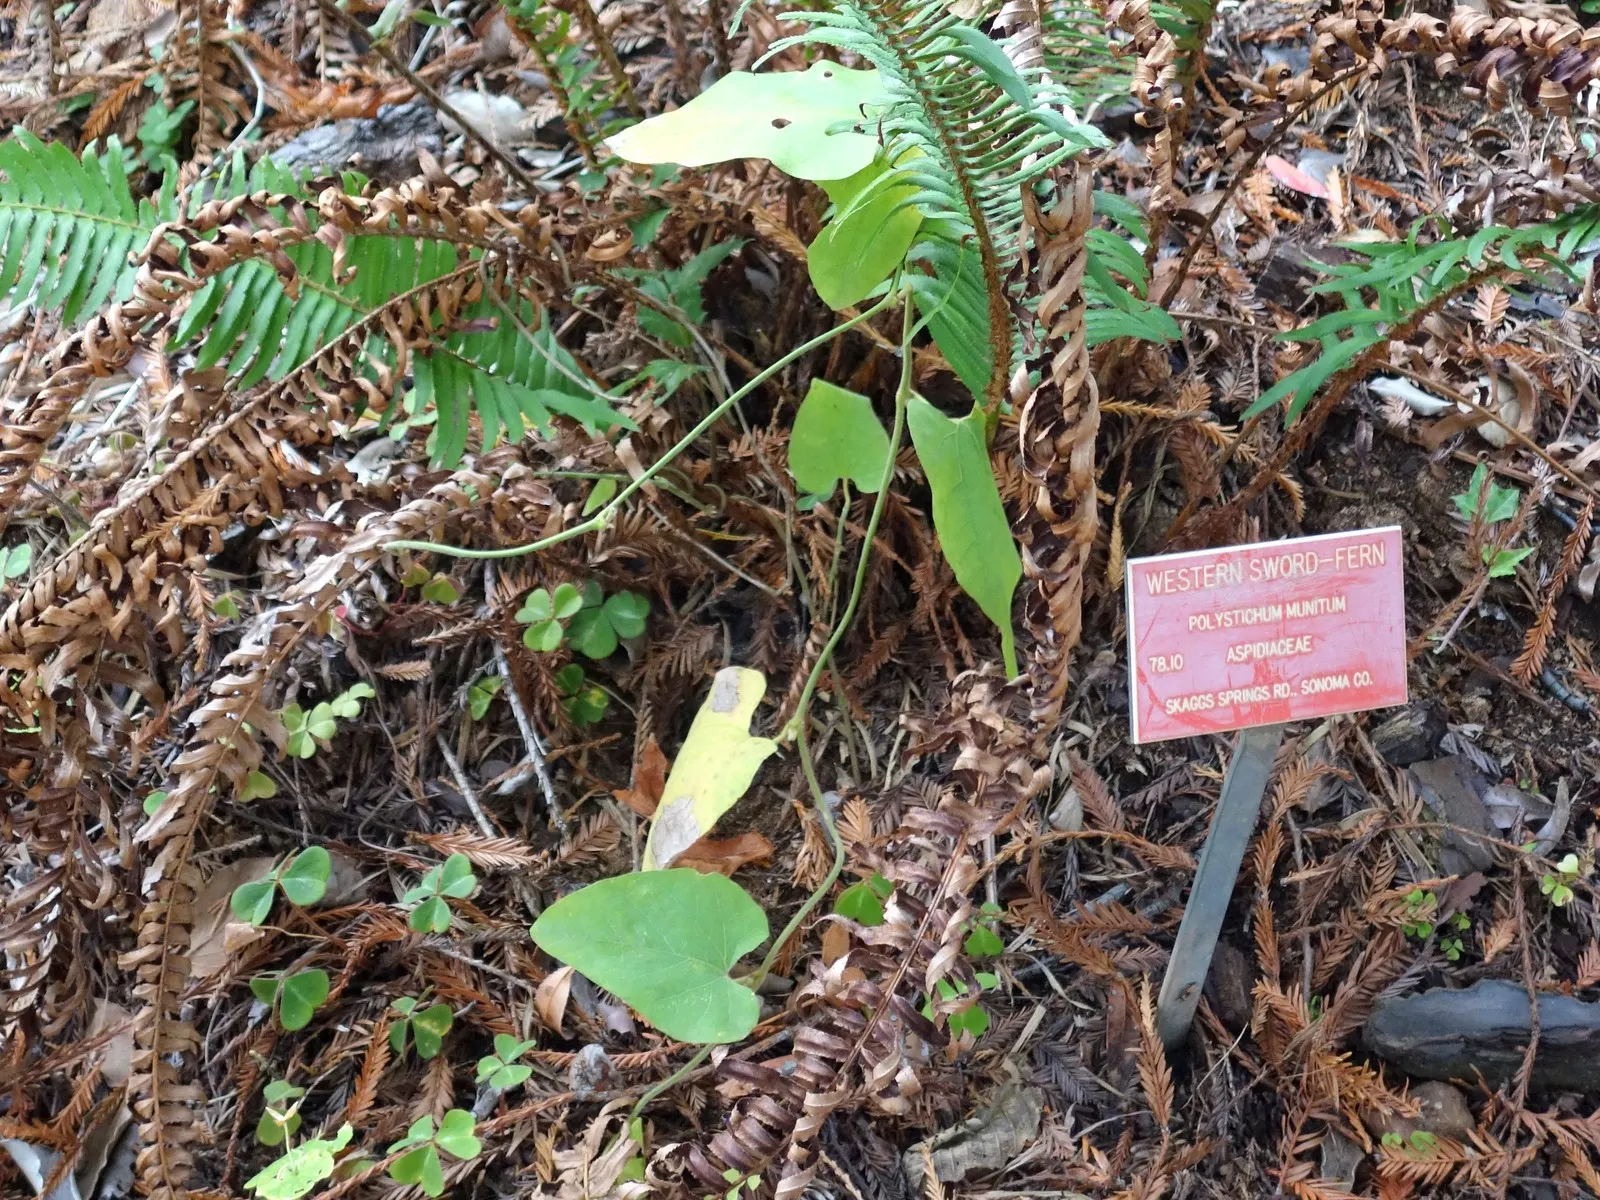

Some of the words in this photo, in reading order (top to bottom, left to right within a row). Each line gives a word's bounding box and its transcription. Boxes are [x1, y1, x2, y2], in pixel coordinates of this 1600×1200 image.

[1145, 560, 1243, 596] WESTERN
[1249, 542, 1386, 582] SWORD-FERN
[1188, 606, 1283, 631] POLYSTICHUM
[1286, 596, 1346, 619] MUNITUM
[1149, 654, 1184, 673] 78.10
[1226, 635, 1313, 663] ASPIDIACEAE
[1165, 692, 1214, 714] SKAGGS
[1217, 685, 1270, 708] SPRINGS
[1301, 674, 1350, 695] SONOMA
[1354, 671, 1374, 686] CO.
